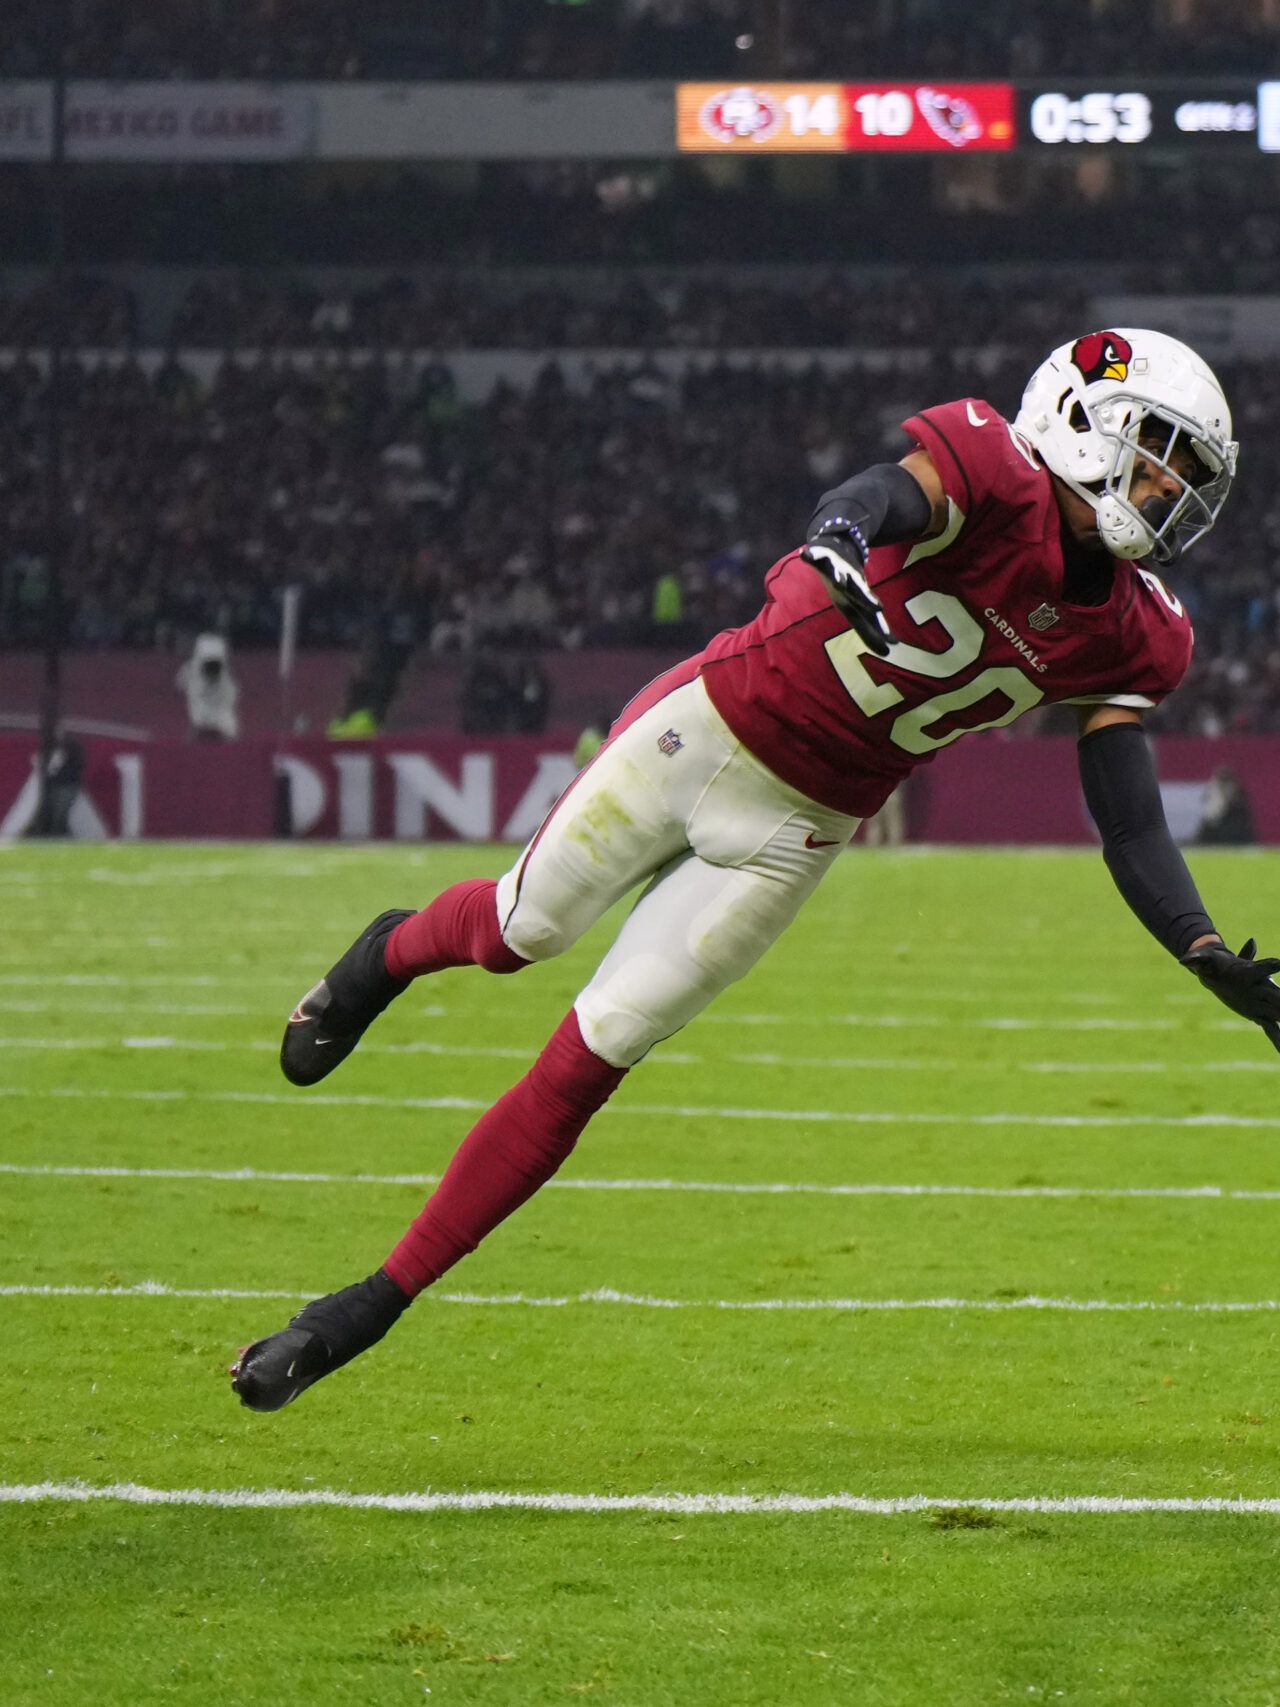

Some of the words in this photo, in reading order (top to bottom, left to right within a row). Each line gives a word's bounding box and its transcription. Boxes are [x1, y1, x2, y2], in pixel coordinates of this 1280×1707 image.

[189, 107, 284, 138] GAME
[785, 94, 840, 136] 14
[855, 91, 913, 136] 10
[1031, 92, 1152, 143] 0:53
[984, 607, 1048, 673] CARDINALS
[824, 590, 1045, 755] 20
